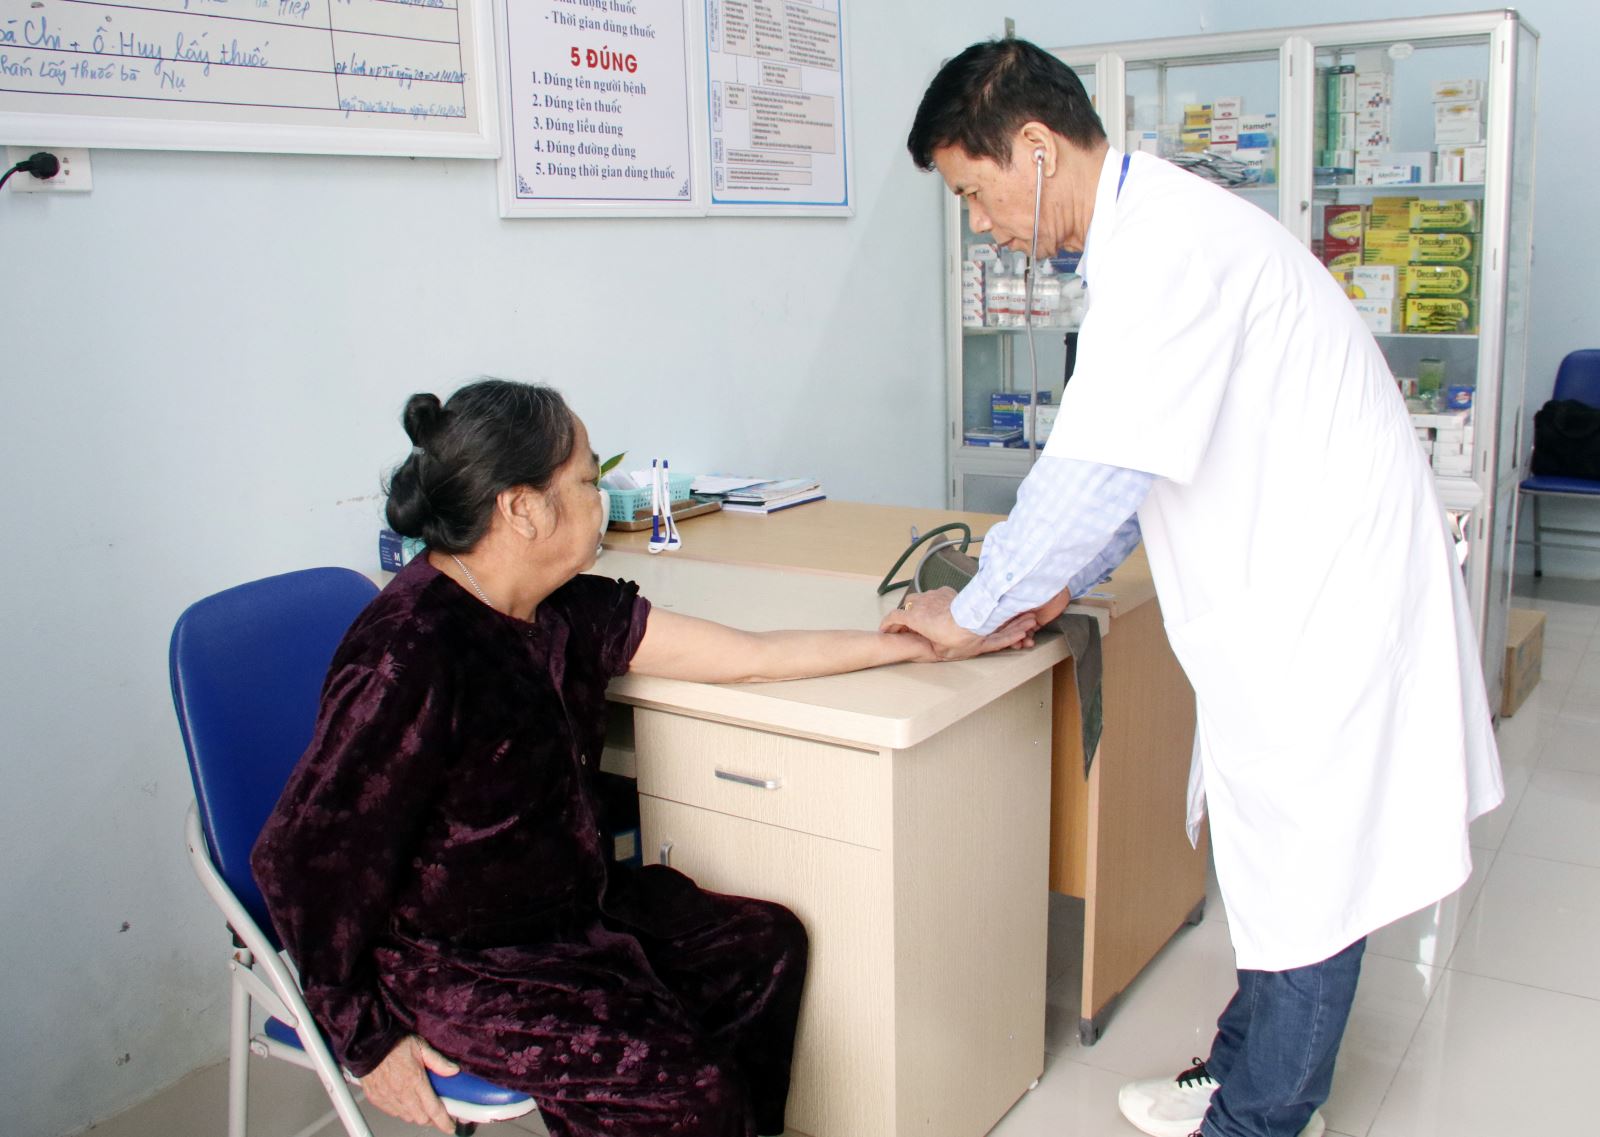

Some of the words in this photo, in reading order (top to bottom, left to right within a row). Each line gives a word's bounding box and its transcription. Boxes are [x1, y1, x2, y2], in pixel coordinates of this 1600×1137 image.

[552, 11, 576, 26] Thời
[579, 16, 601, 30] gian
[603, 20, 628, 37] dùng
[630, 24, 656, 39] thuốc
[119, 32, 162, 75] Huy
[173, 32, 210, 77] lấy
[219, 39, 269, 67] thuốc
[571, 46, 581, 67] 5
[586, 45, 638, 73] ĐÚNG
[532, 71, 541, 84] 1.
[544, 72, 573, 90] Đúng
[575, 76, 591, 89] tên
[594, 80, 621, 93] người
[623, 81, 646, 97] bệnh
[532, 93, 542, 107] 2.
[545, 95, 574, 112] Đúng
[576, 98, 592, 111] tên
[594, 98, 622, 114] thuốc
[533, 116, 543, 130] 3.
[545, 117, 575, 135] Đúng
[577, 118, 596, 133] liều
[598, 122, 624, 138] dùng
[534, 139, 544, 153] 4.
[547, 140, 575, 157] Đúng
[577, 142, 610, 159] đường
[611, 144, 637, 159] dùng
[535, 162, 546, 176] 5.
[548, 162, 577, 180] Đúng
[579, 164, 599, 177] thời
[601, 165, 622, 180] gian
[624, 166, 648, 180] dùng
[650, 166, 676, 180] thuốc
[1453, 236, 1464, 246] ND
[1451, 269, 1462, 279] ND
